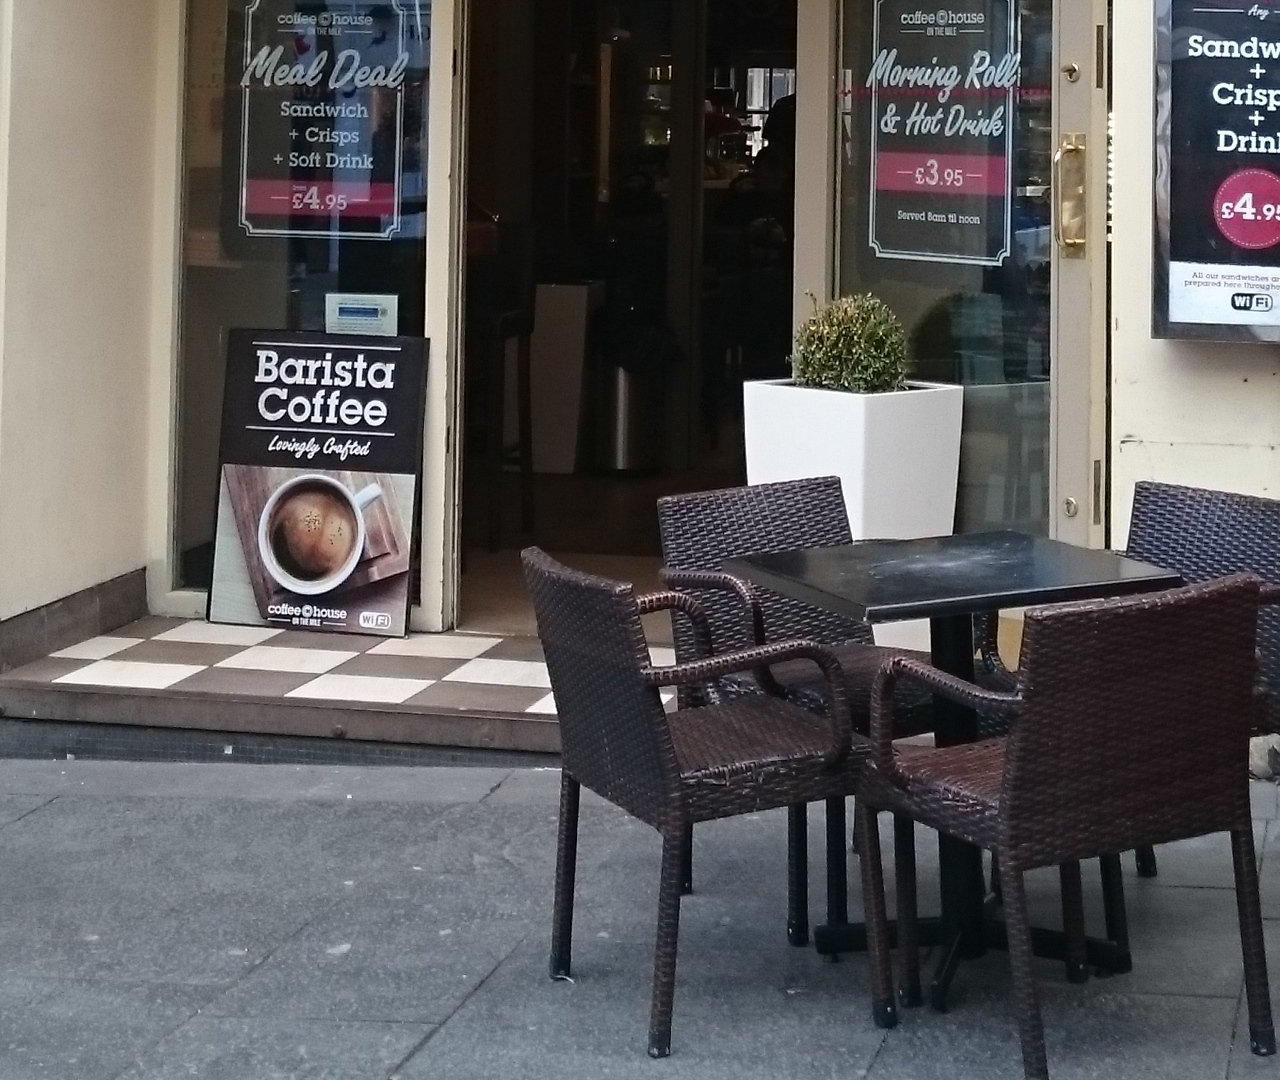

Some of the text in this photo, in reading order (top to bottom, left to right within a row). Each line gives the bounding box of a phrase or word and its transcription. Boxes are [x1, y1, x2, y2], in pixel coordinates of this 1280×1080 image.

[277, 12, 317, 25] coffee
[332, 13, 373, 26] house
[901, 10, 936, 24] coffee
[948, 10, 985, 24] house
[1247, 4, 1270, 20] Any
[240, 45, 410, 90] Meal Deal
[866, 48, 1020, 103] Morning Roll
[280, 101, 369, 118] Sandwich
[880, 101, 1005, 138] & Hot Drink
[289, 126, 360, 147] + Crisps
[273, 152, 374, 170] + Soft Drink
[915, 159, 963, 187] £3.95
[292, 185, 348, 211] £4.95
[897, 210, 981, 225] Served 8am til noon
[1184, 280, 1221, 288] prepared
[1221, 273, 1269, 282] sandwiches
[254, 349, 395, 390] Barista
[257, 386, 388, 427] Coffee
[267, 434, 370, 461] Lovingly Crafted
[267, 603, 301, 616] coffee
[313, 605, 347, 619] house
